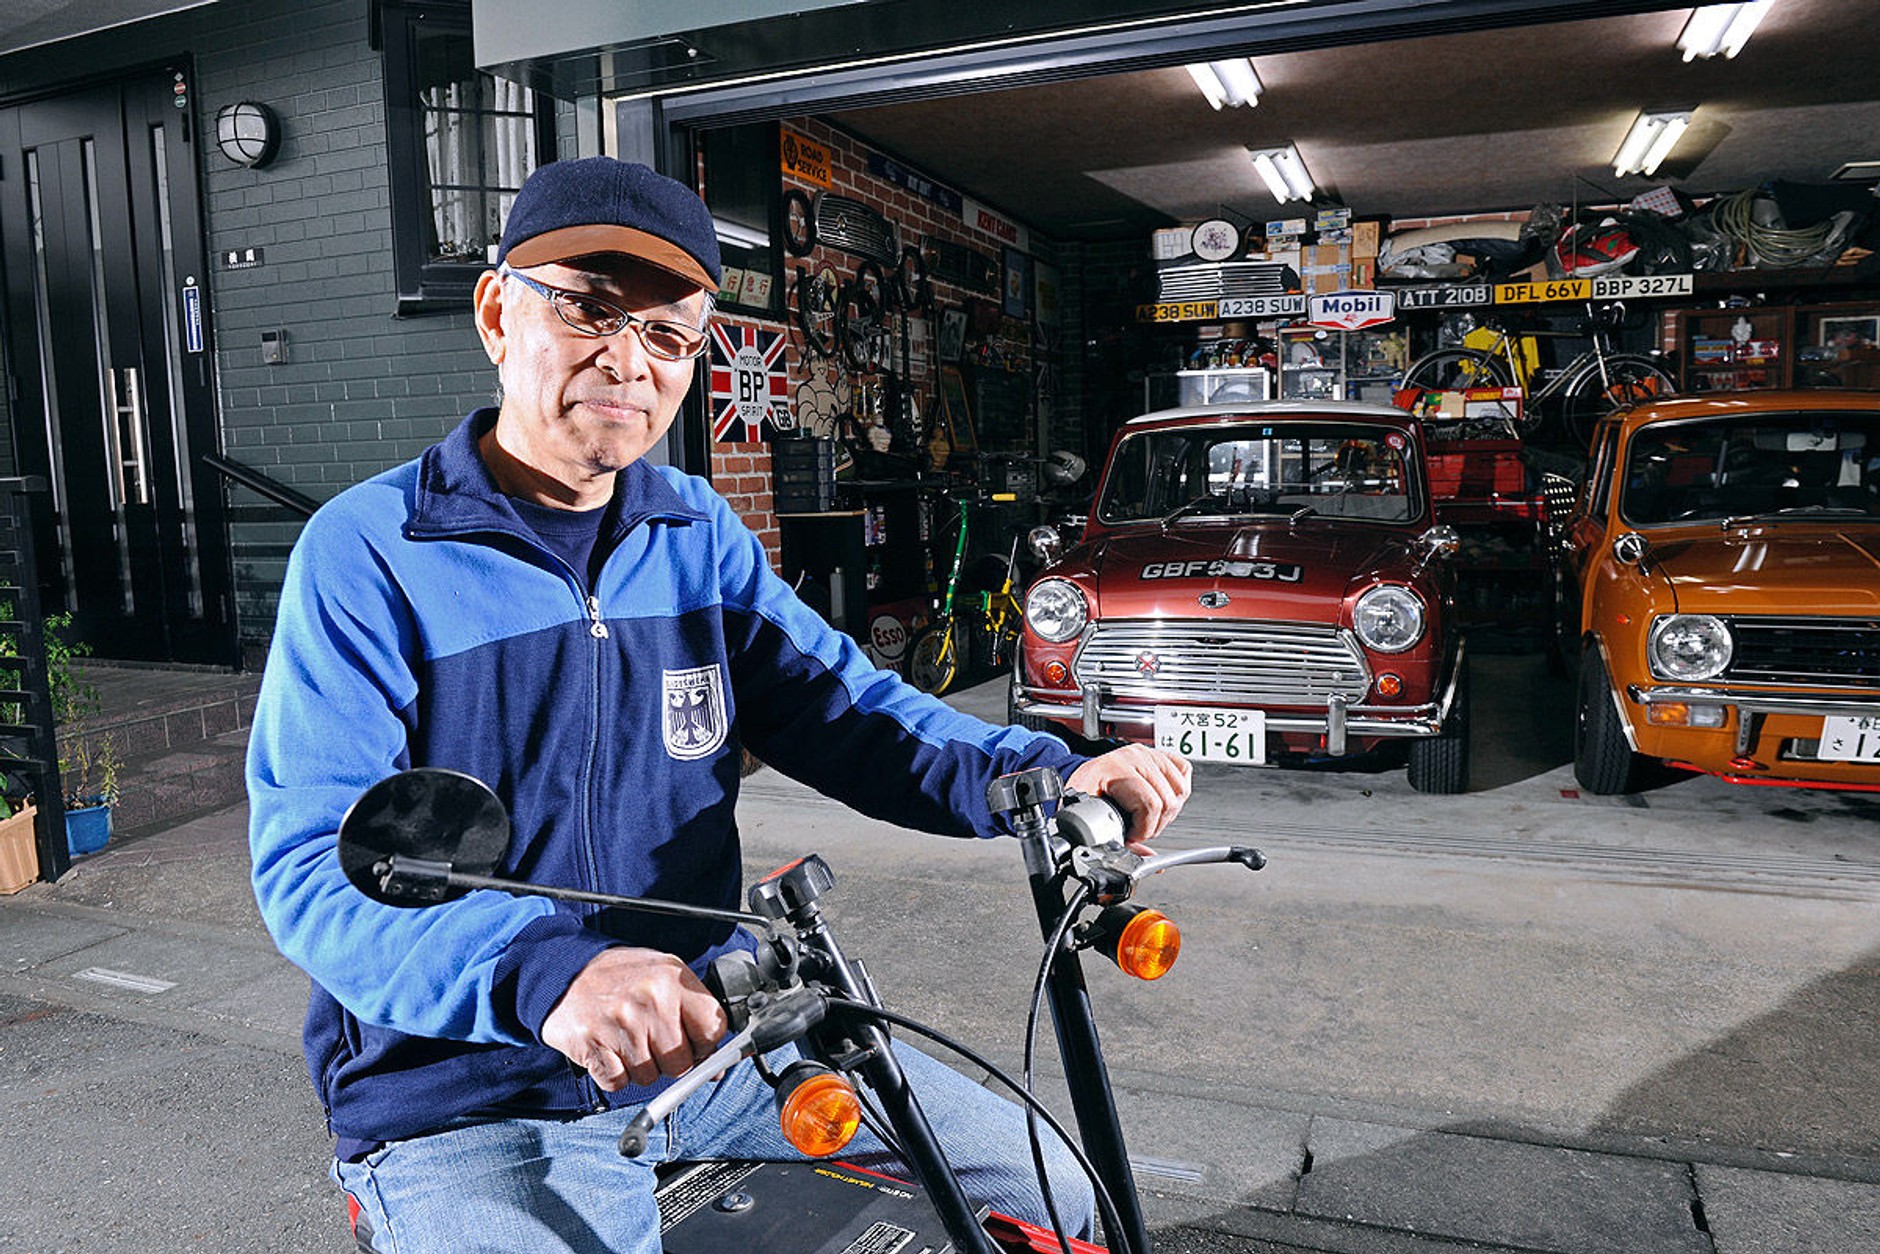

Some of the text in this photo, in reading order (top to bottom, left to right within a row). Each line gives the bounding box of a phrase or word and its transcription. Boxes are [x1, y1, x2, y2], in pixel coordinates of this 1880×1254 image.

[800, 143, 824, 164] ROAD
[797, 159, 827, 182] SERVICE
[1504, 282, 1583, 301] DFL 66V
[1595, 277, 1690, 296] BBP 327L
[1221, 297, 1303, 315] A238 SUW
[1322, 297, 1381, 313] Mobil
[1403, 288, 1487, 307] ATT 210B
[1138, 304, 1216, 320] A238 SUW
[739, 355, 763, 367] MOTOR
[741, 405, 763, 417] SPIRIT
[776, 409, 793, 428] GB
[1161, 730, 1254, 759] は 61-61
